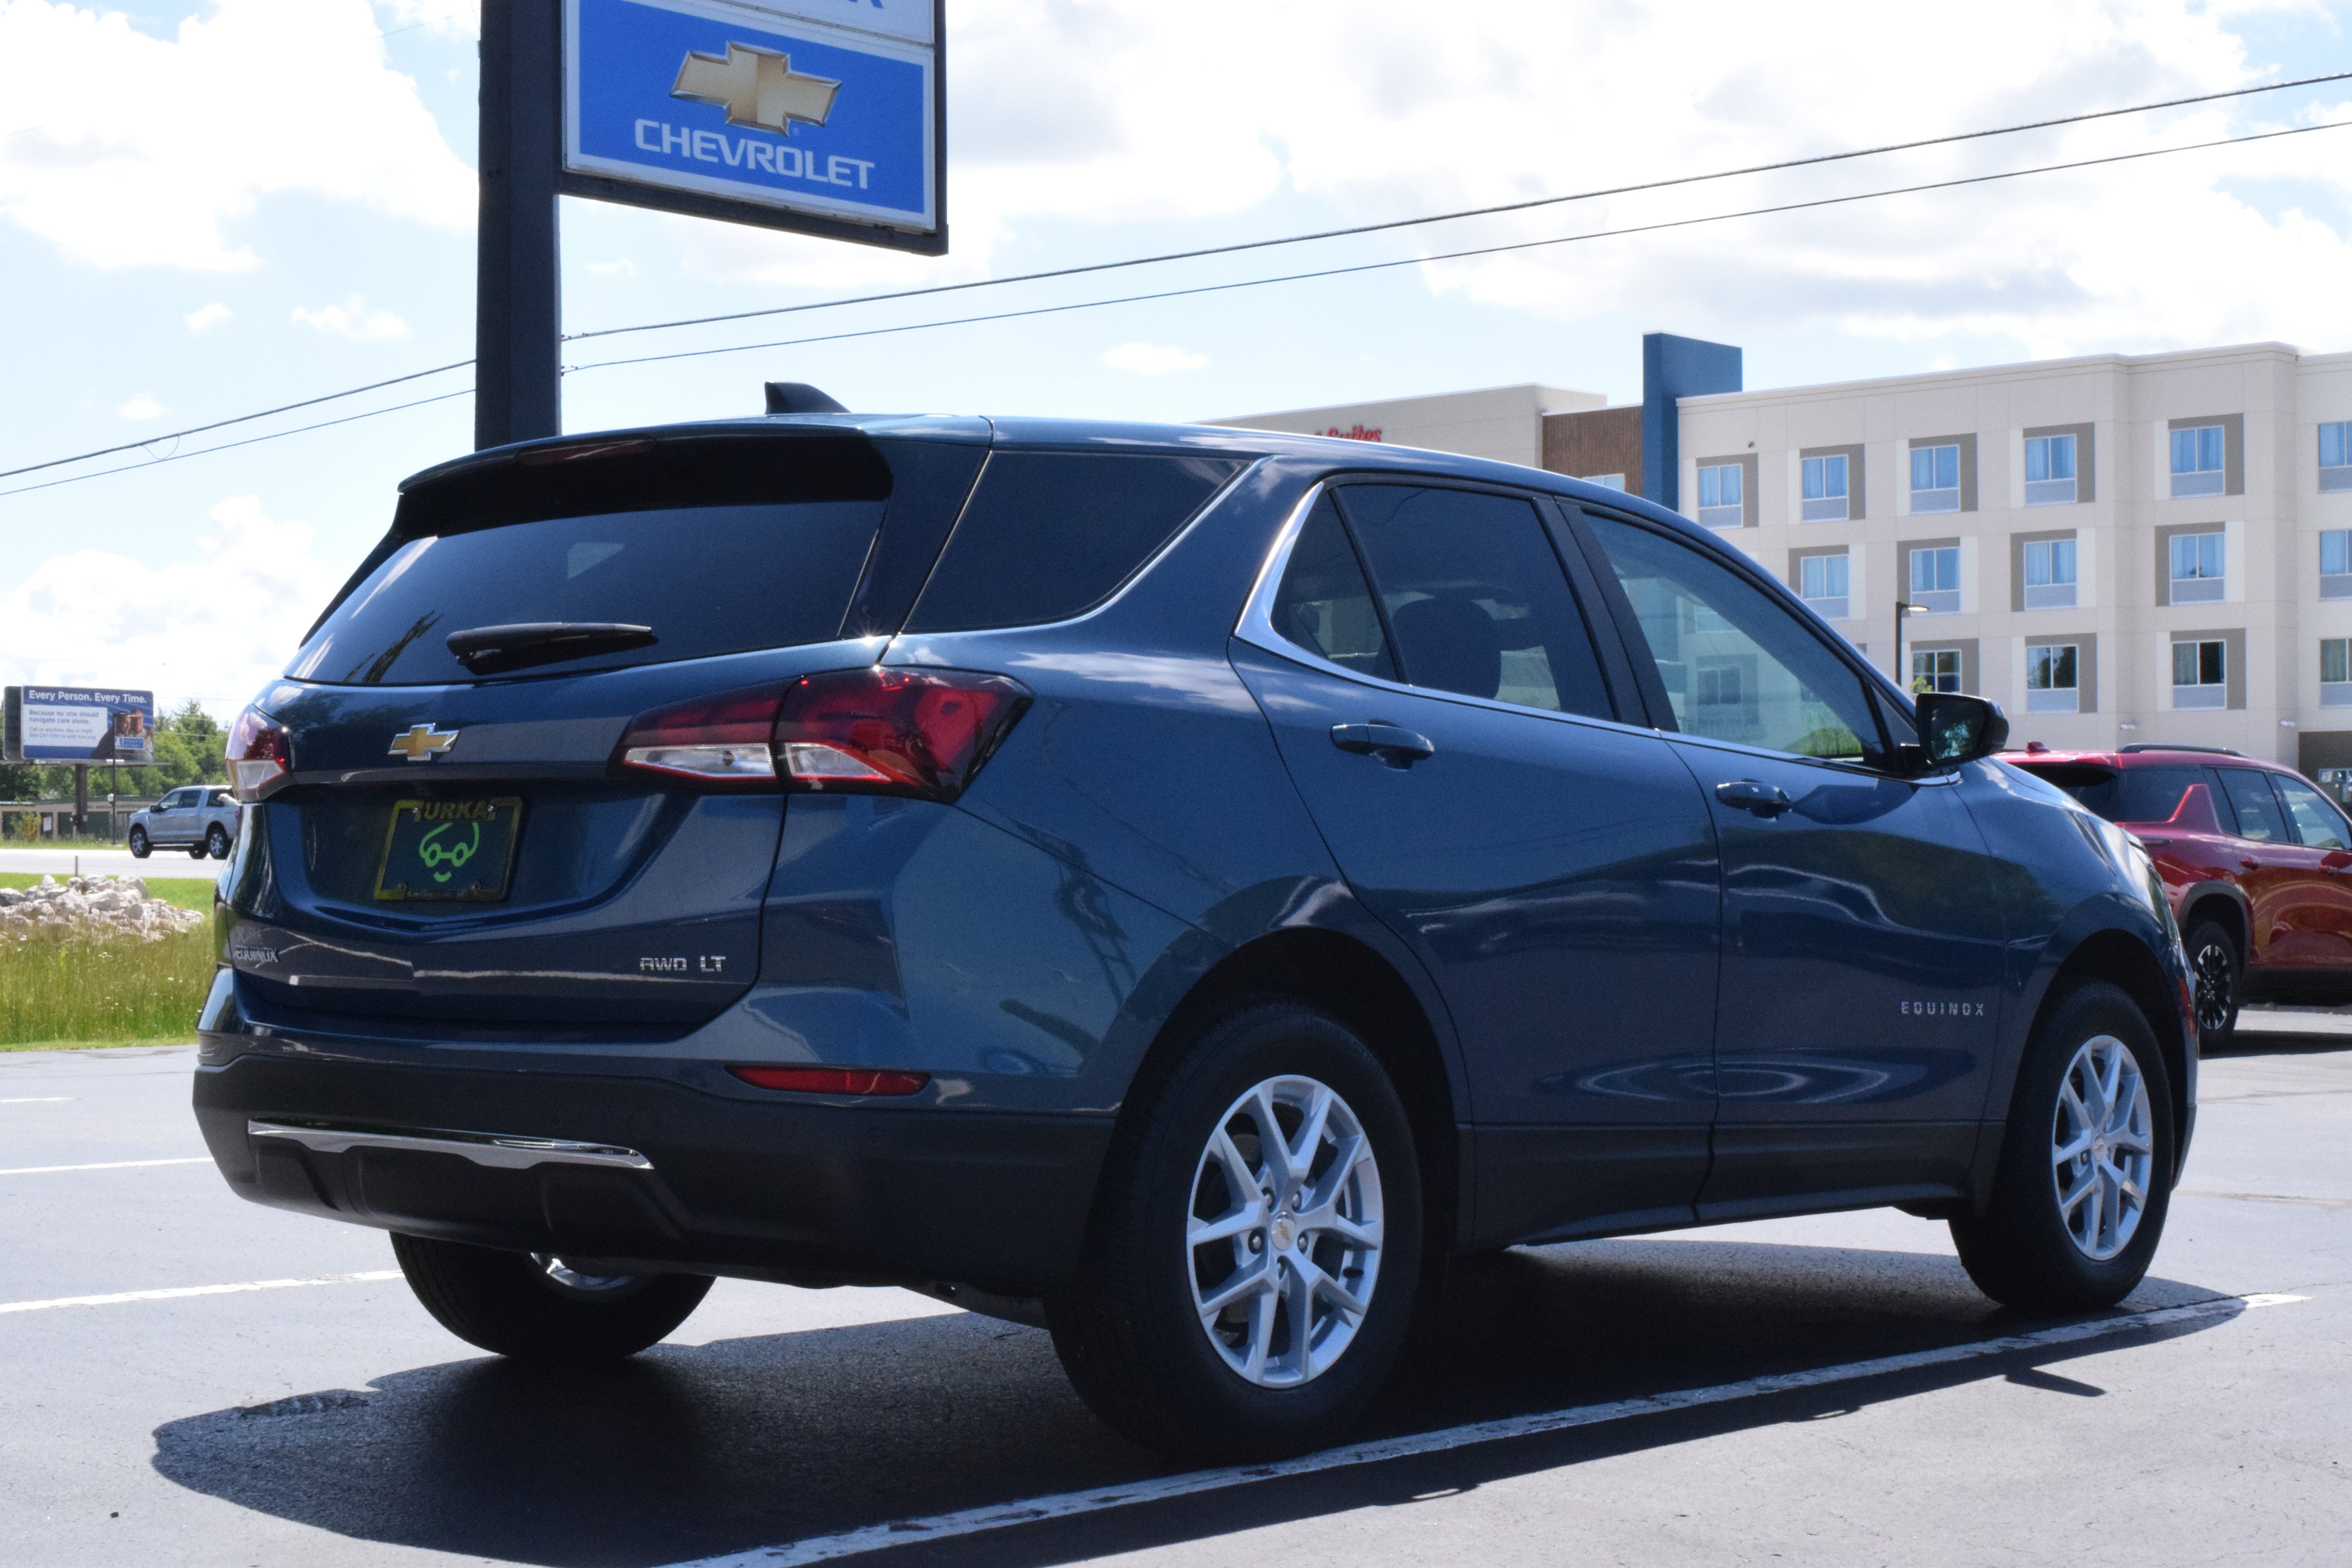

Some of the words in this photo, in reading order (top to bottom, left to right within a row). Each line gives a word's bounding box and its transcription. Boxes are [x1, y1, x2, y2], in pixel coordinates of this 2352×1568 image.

[634, 118, 875, 189] CHEVROLET
[29, 689, 56, 701] Every
[58, 691, 92, 702] Person.
[94, 693, 120, 704] Every
[122, 694, 147, 703] Time.
[640, 958, 687, 971] AWD
[700, 956, 726, 972] LT
[1900, 1001, 1984, 1016] EQUINOX
